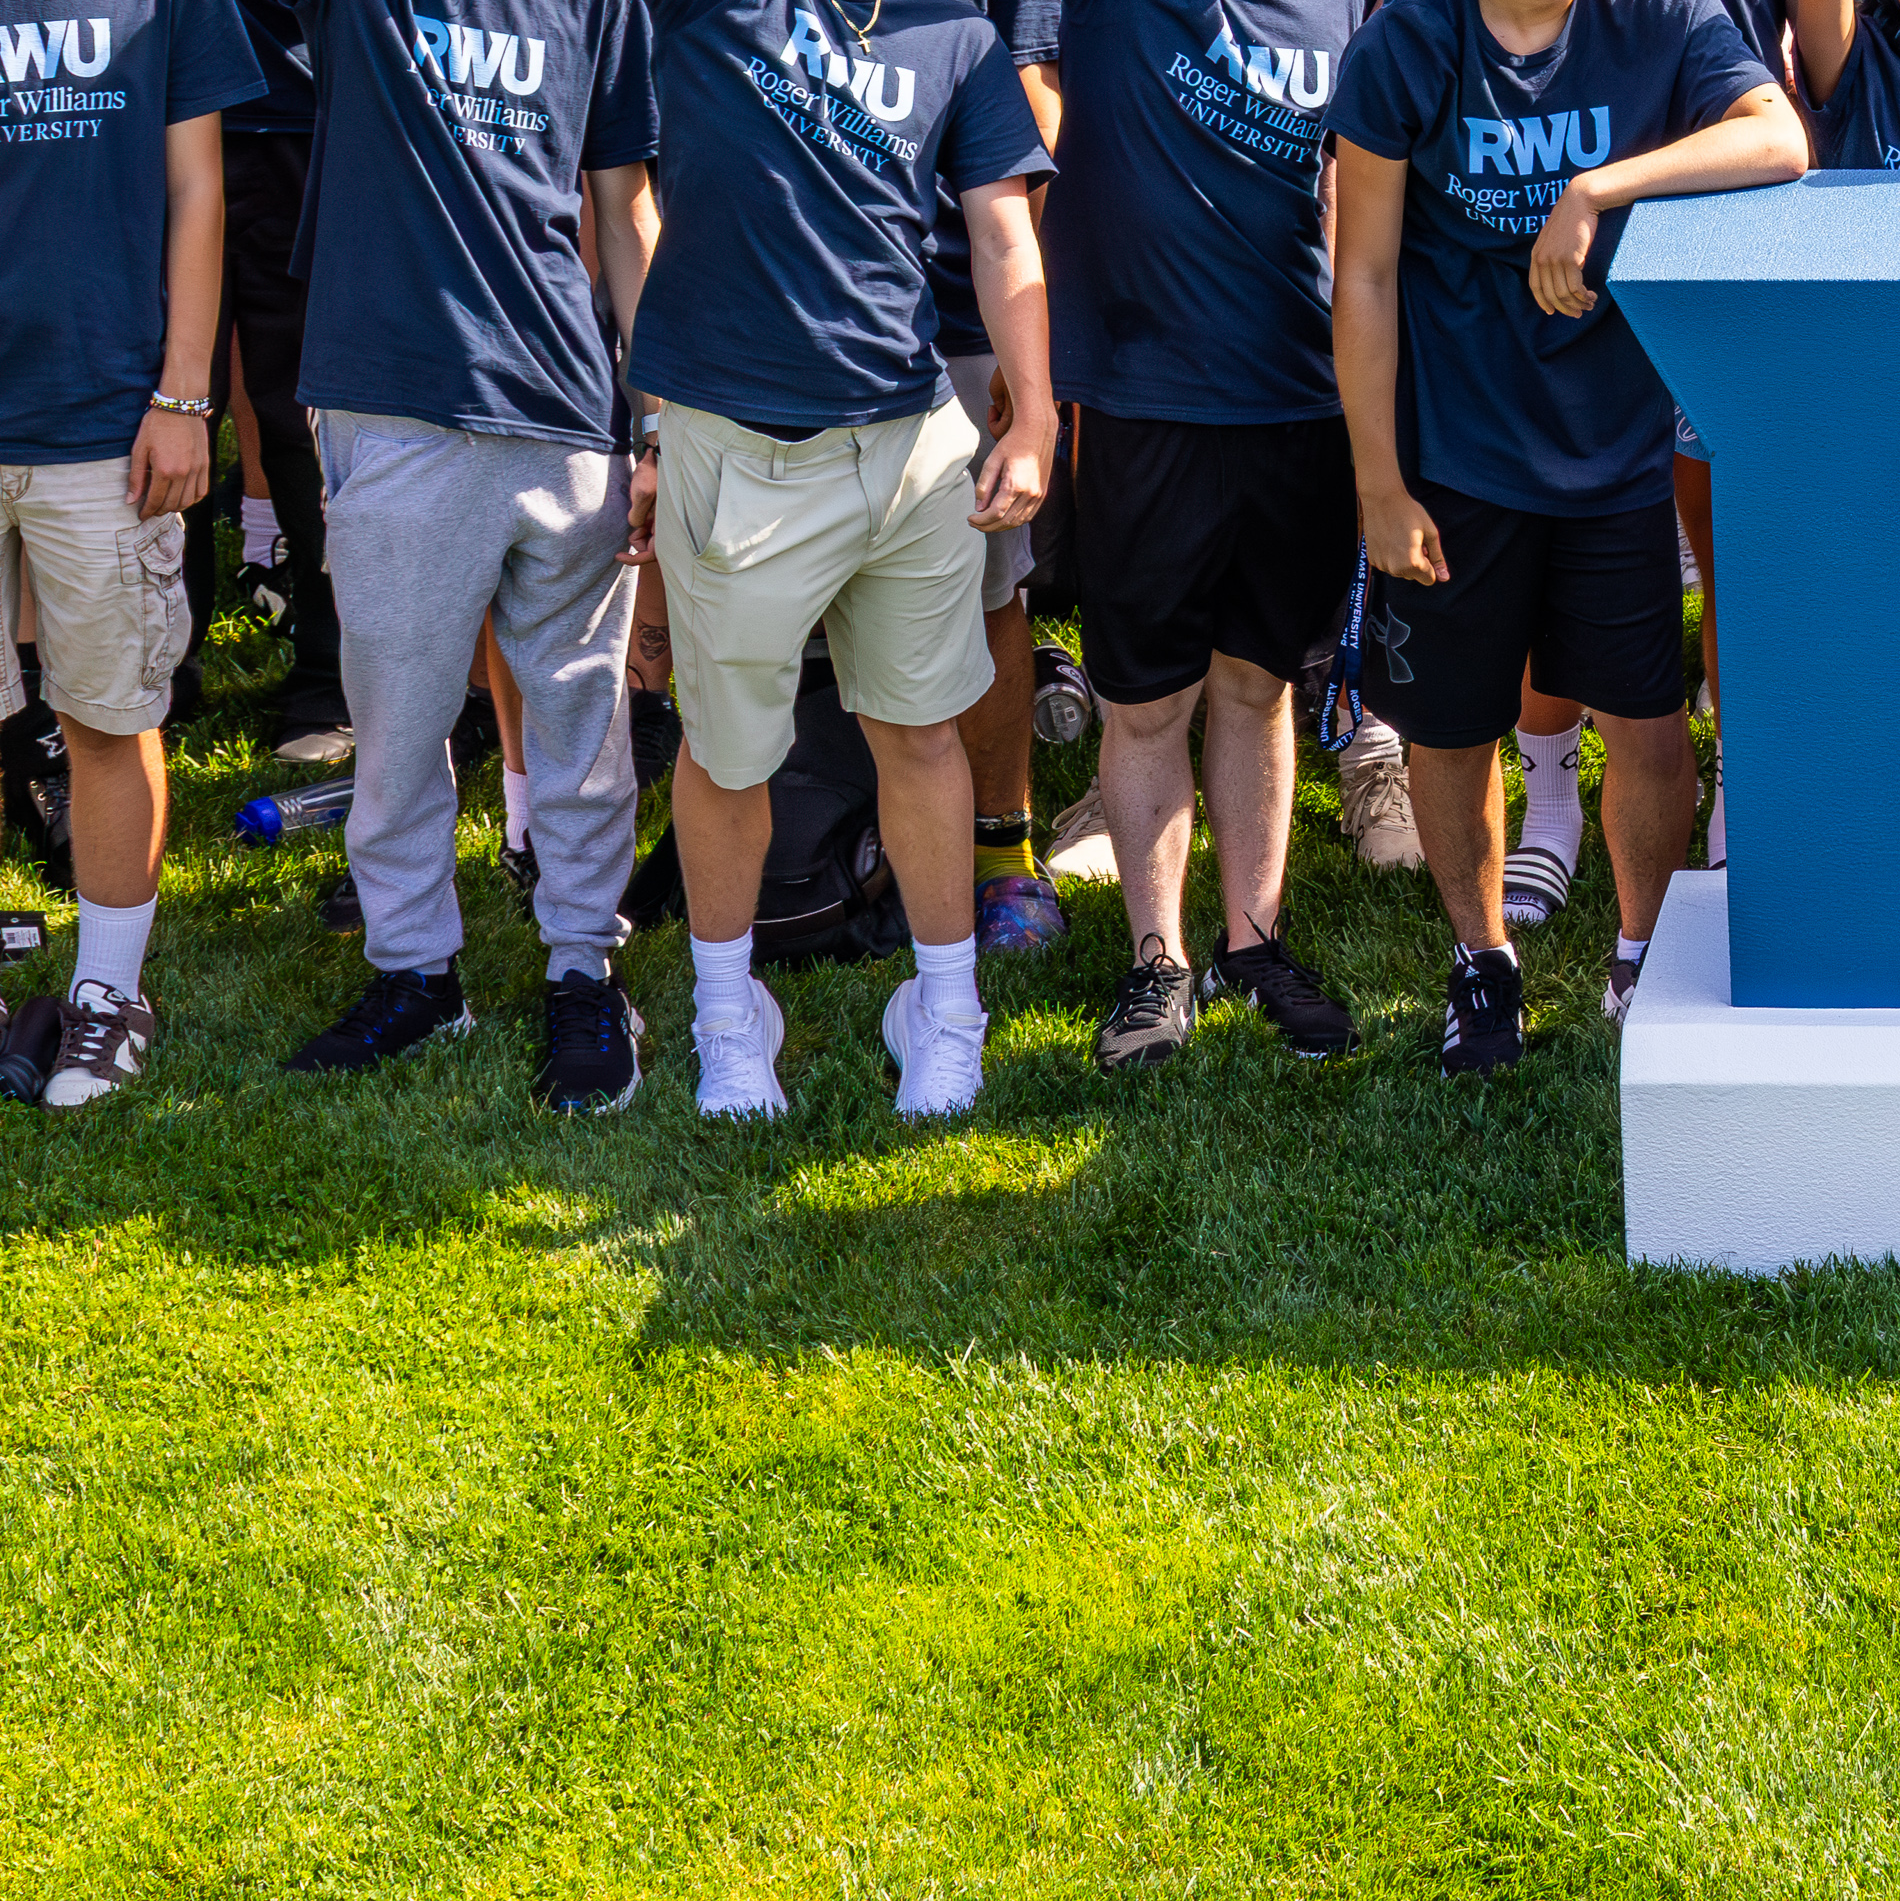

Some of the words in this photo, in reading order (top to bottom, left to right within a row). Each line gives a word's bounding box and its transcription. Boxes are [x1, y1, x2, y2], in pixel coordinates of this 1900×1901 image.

[409, 16, 546, 97] RWU
[779, 8, 917, 123] RWU
[1167, 53, 1240, 109] Roger
[2, 118, 103, 141] VERSITY
[16, 87, 126, 117] Williams
[452, 96, 550, 134] Williams
[743, 55, 822, 113] Roger
[823, 92, 919, 163] Williams
[1178, 92, 1311, 165] UNIVERSITY
[455, 123, 526, 157] ERSITY
[764, 97, 889, 174] UNIVERSITY
[1462, 107, 1611, 177] RWU
[1445, 172, 1520, 210] Roger
[1524, 180, 1572, 208] Will
[1466, 207, 1549, 234] UNIVER
